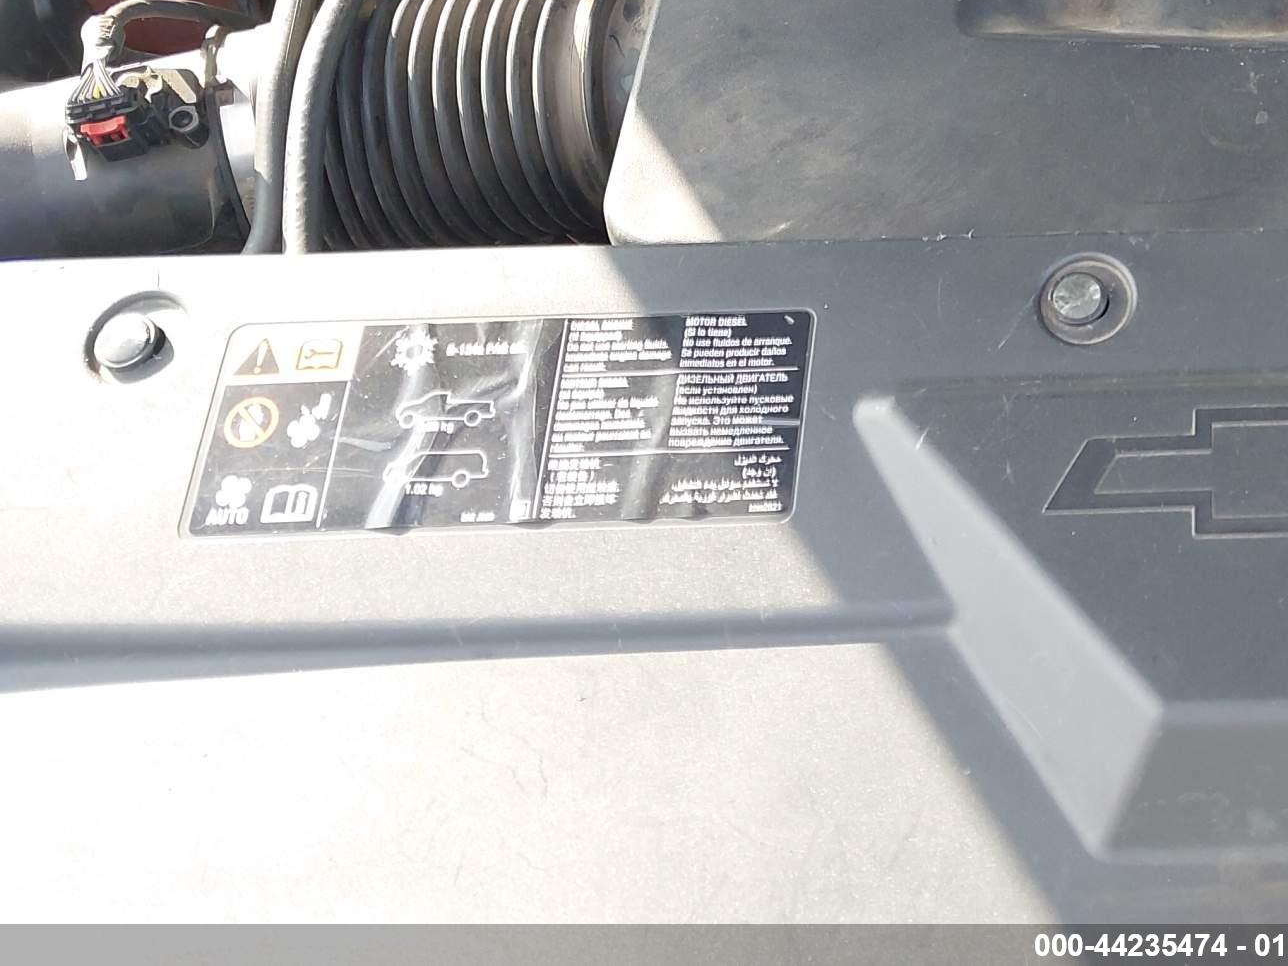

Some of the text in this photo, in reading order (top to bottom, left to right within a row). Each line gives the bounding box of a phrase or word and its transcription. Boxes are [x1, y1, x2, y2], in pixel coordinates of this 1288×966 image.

[685, 316, 748, 327] MOTOR DIESEL
[698, 327, 706, 337] lo
[707, 327, 732, 338] tiene)
[683, 336, 793, 347] No use fluidos de arranque.
[681, 346, 786, 359] Se pueden producir daños
[726, 359, 736, 367] en
[738, 357, 747, 367] el
[748, 357, 775, 367] motor.
[677, 372, 788, 384] ДИЗЕЛЬНЫЙ ДВИГАТЕЛЬ
[703, 384, 758, 395] установлен)
[674, 394, 794, 406] Не используйте пусковые
[672, 405, 789, 415] жидкости для холодного
[712, 416, 730, 425] Это
[732, 415, 763, 425] может
[710, 426, 773, 436] немедленное
[205, 507, 249, 526] AUTO
